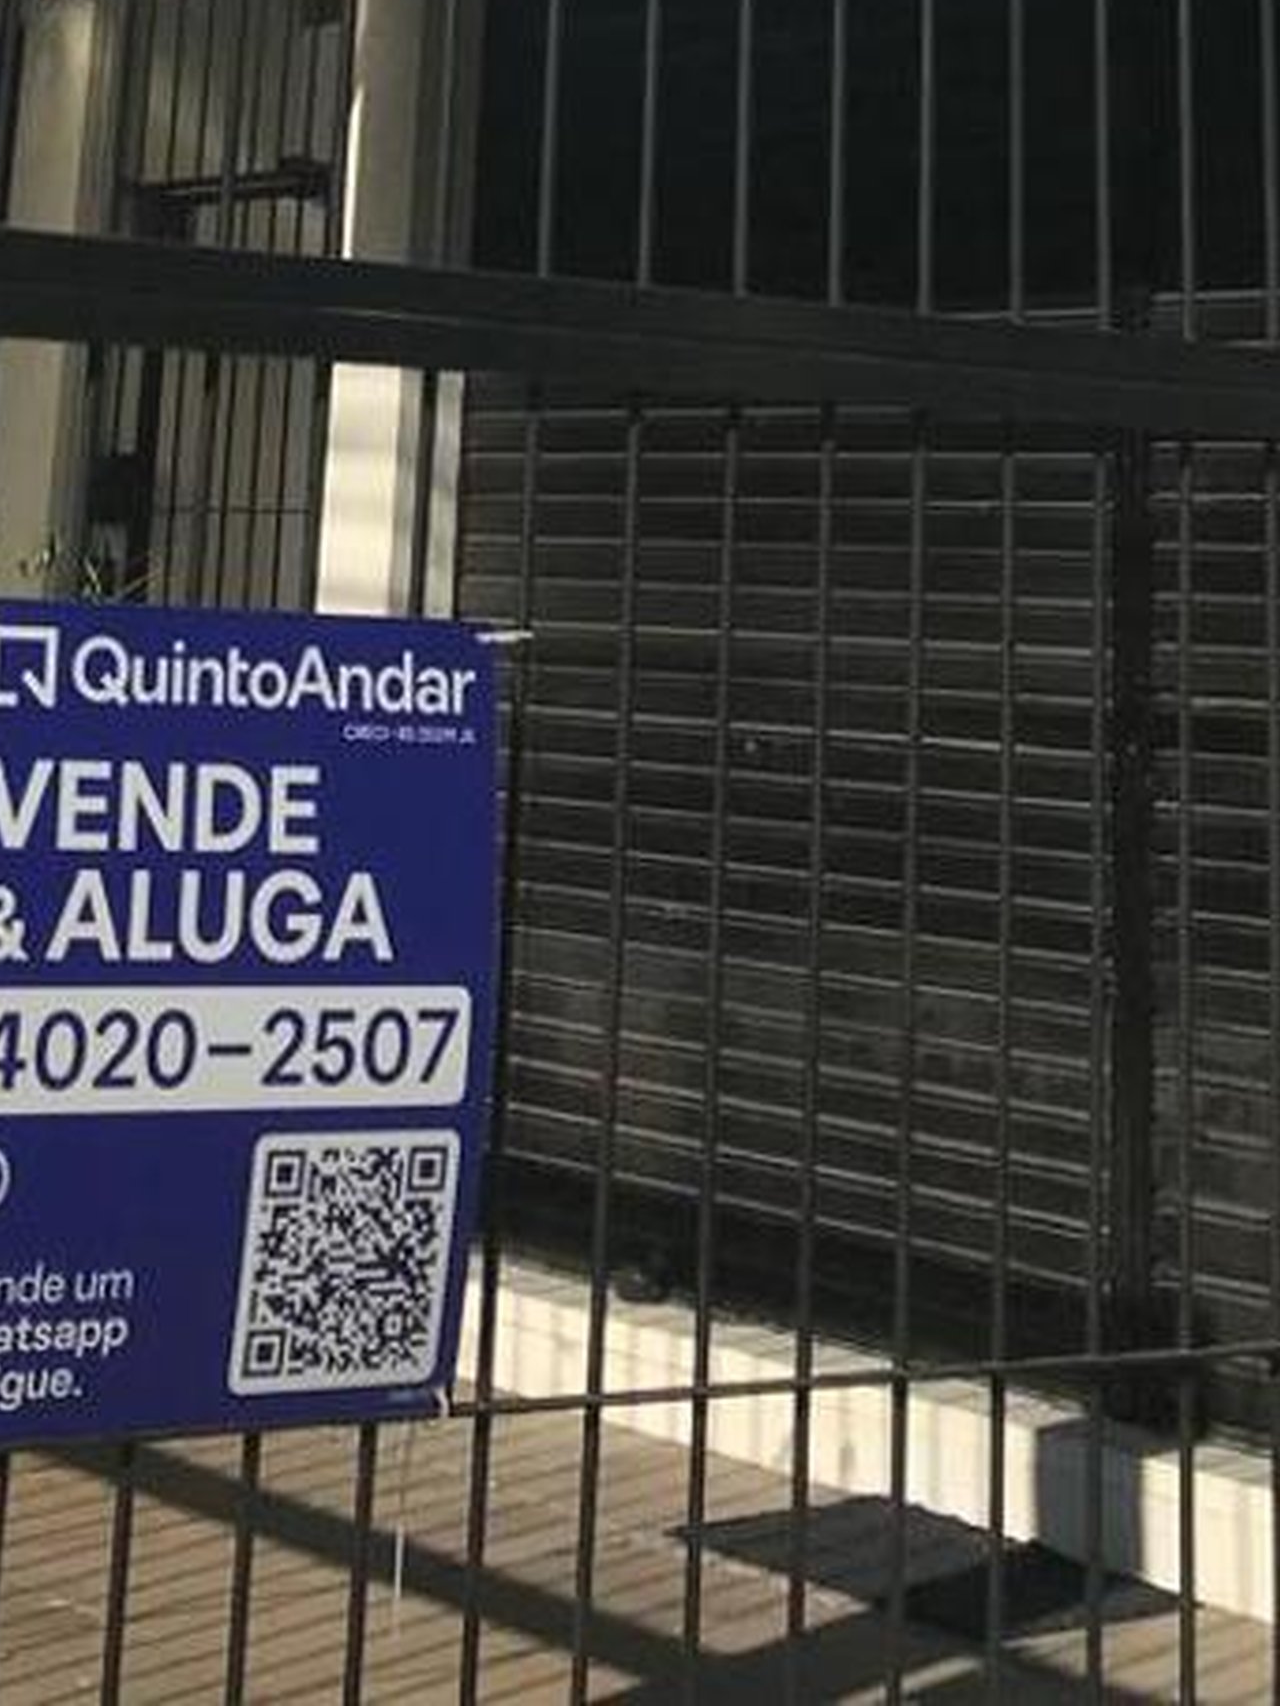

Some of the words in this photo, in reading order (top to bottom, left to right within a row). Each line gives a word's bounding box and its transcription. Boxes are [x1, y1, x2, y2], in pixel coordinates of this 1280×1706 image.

[71, 635, 477, 715] QuintoAndar
[45, 868, 394, 963] ALUGA
[74, 1268, 135, 1302] um
